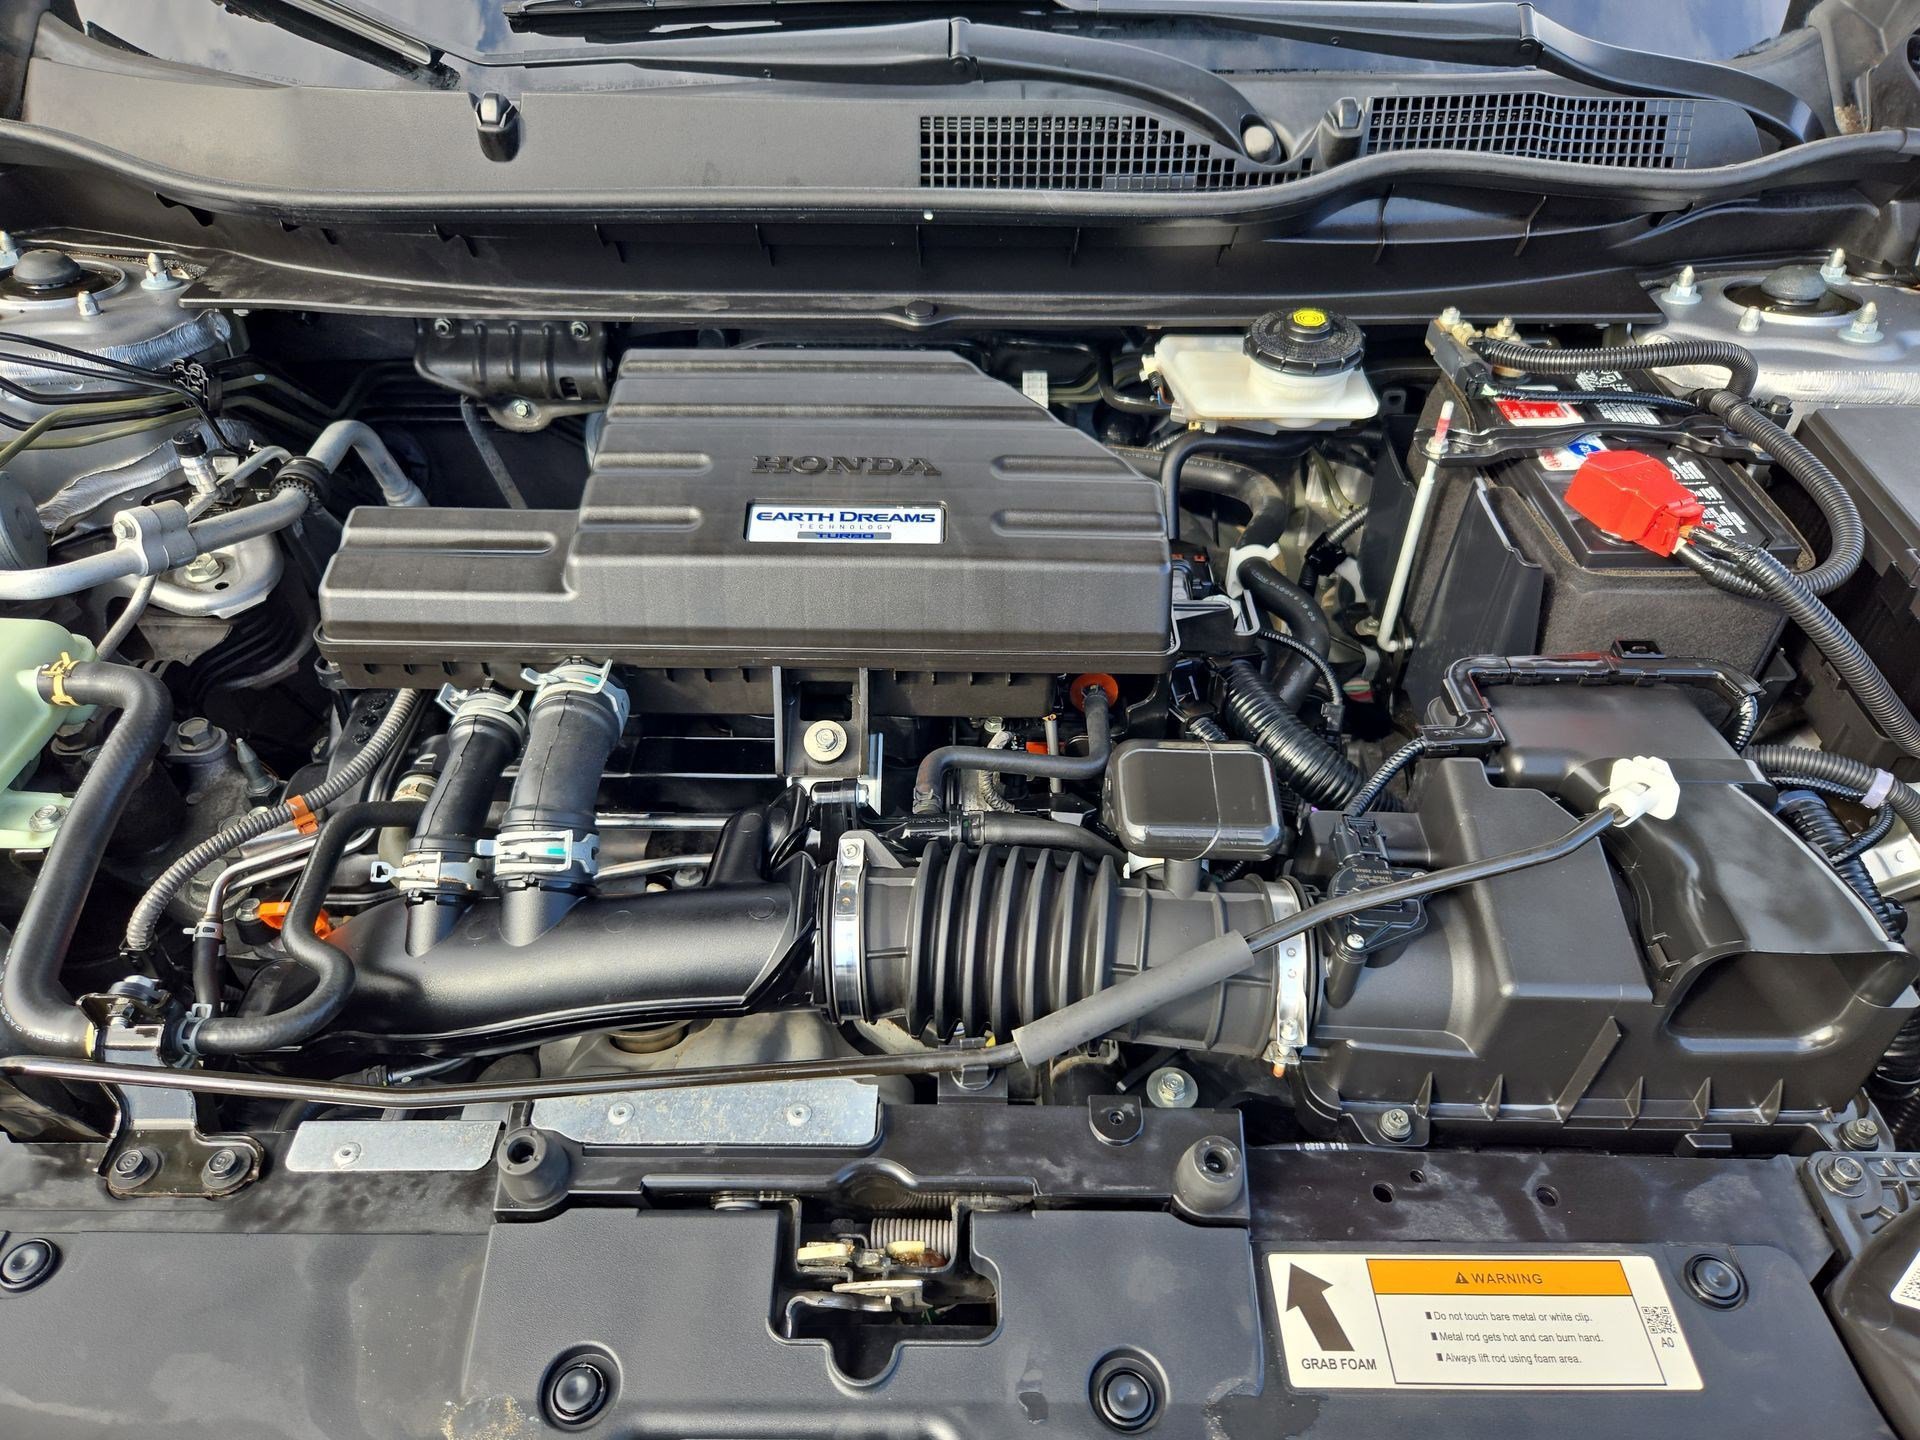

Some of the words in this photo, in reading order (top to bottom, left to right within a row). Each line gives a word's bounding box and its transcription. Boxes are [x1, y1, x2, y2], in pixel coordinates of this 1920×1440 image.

[751, 455, 942, 476] HONDA
[756, 512, 834, 522] EARTH
[839, 511, 936, 523] DREAMS
[1471, 1273, 1543, 1285] WARNING
[1433, 1311, 1447, 1321] Do
[1449, 1312, 1463, 1321] not
[1464, 1311, 1489, 1321] touch
[1490, 1311, 1511, 1322] bare
[1512, 1311, 1537, 1322] metal
[1538, 1314, 1547, 1322] or
[1550, 1312, 1573, 1322] white
[1574, 1312, 1593, 1324] clip.
[1439, 1332, 1463, 1341] Metal
[1466, 1332, 1481, 1342] rod
[1482, 1333, 1501, 1344] gets
[1503, 1333, 1518, 1342] hot
[1520, 1332, 1536, 1342] and
[1556, 1333, 1576, 1342] burn
[1578, 1333, 1604, 1343] hand.
[1301, 1358, 1338, 1370] GRAB
[1341, 1358, 1377, 1371] FOAM
[1445, 1352, 1476, 1364] Always
[1478, 1353, 1489, 1362] lift
[1491, 1353, 1506, 1363] rod
[1508, 1353, 1533, 1365] using
[1534, 1353, 1557, 1363] foam
[1559, 1356, 1582, 1364] area.
